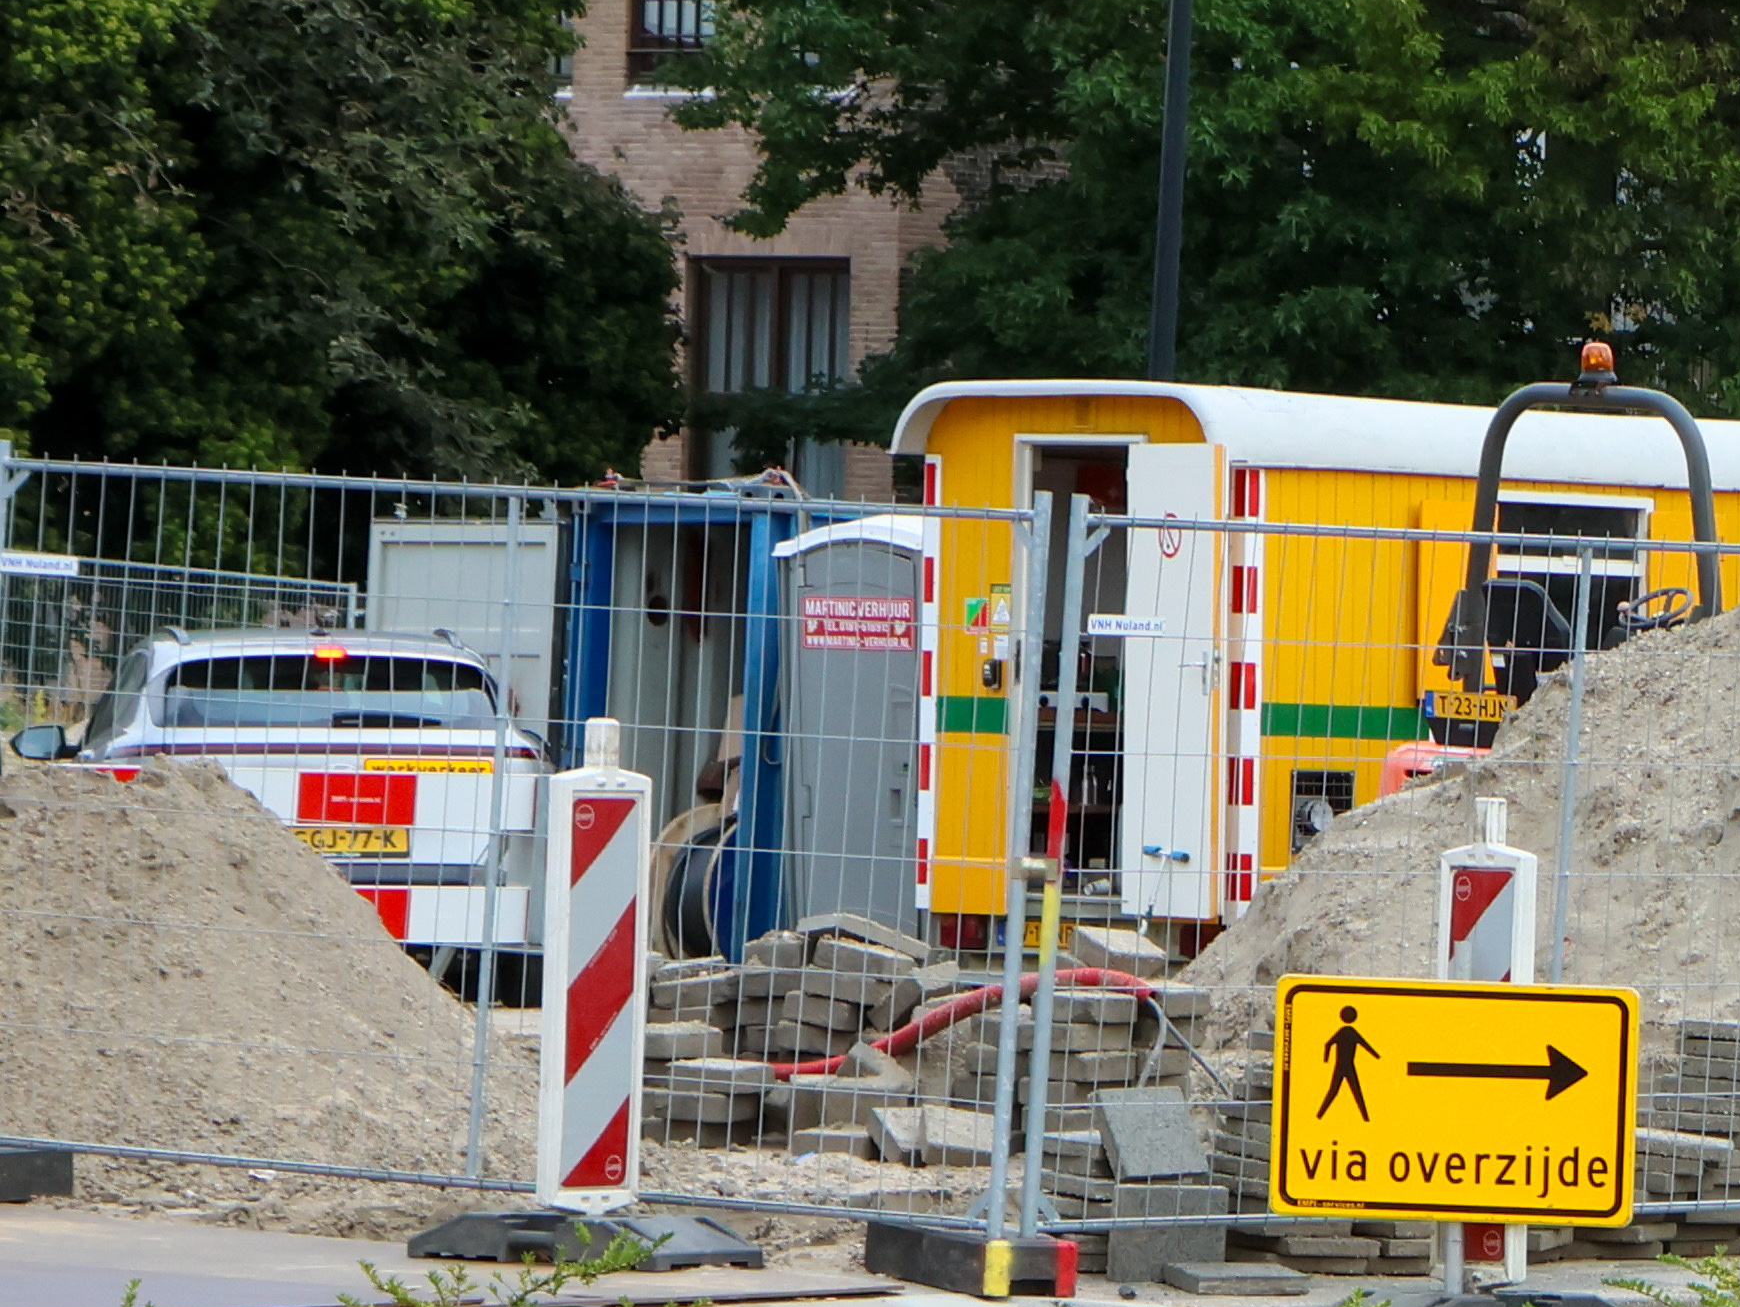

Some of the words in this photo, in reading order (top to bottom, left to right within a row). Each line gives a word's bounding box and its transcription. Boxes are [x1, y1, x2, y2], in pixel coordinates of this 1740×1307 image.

[1091, 619, 1112, 630] VNH
[1115, 620, 1163, 631] Nuland.nl
[1299, 1140, 1367, 1182] via
[1389, 1145, 1609, 1199] overzijde
